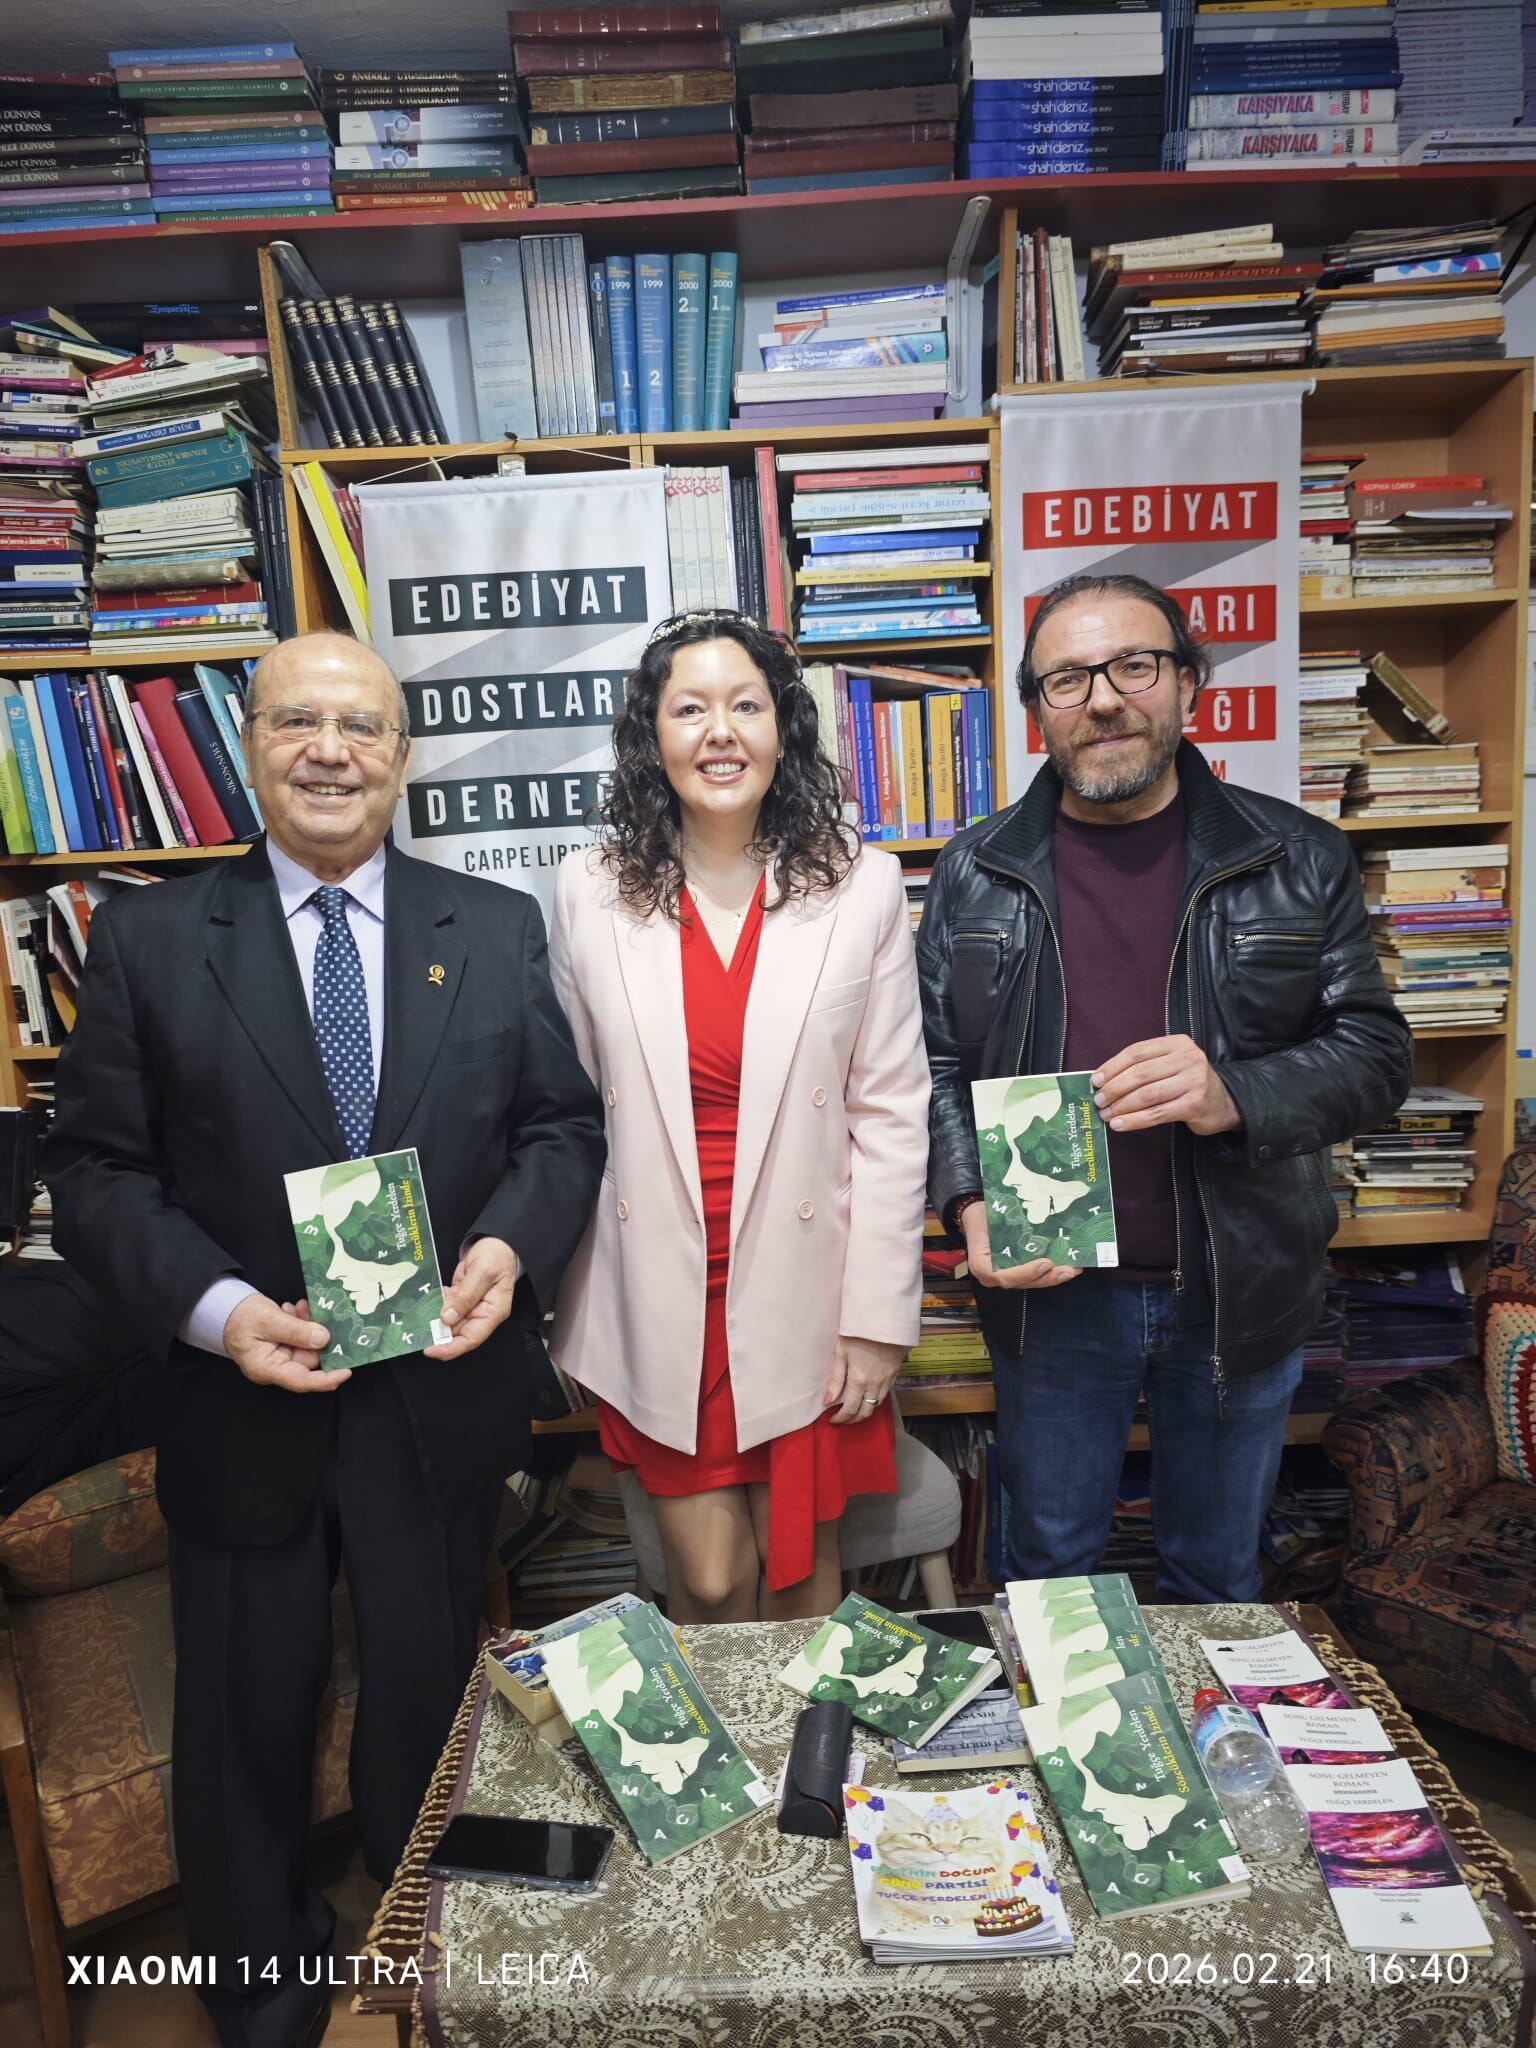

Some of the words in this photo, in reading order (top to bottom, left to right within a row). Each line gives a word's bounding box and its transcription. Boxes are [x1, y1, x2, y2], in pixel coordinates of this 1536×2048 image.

[1238, 96, 1314, 119] KARŞIYAKA
[1242, 134, 1318, 158] KARŞIYAKA
[611, 282, 630, 290] 1999
[643, 280, 663, 289] 1999
[678, 282, 698, 290] 2000
[713, 280, 733, 289] 2000
[678, 297, 688, 313] 2
[1044, 487, 1257, 538] EDEBİYAT
[411, 573, 626, 624] EDEBİYAT
[464, 846, 530, 872] CARPE
[1065, 1103, 1076, 1140] Yerdelen
[1068, 1142, 1081, 1170] Tuğçe
[1082, 1131, 1096, 1182] Sözcüklerin
[386, 1182, 400, 1223] Yerdelen
[392, 1222, 407, 1251] Tuğçe
[406, 1206, 423, 1260] Sözcüklerin
[650, 1667, 674, 1703] Yerdelen
[668, 1704, 689, 1728] Tuğçe
[675, 1688, 710, 1734] Sözcüklerin
[1129, 1710, 1151, 1752] Yerdelen
[1149, 1753, 1167, 1782] Tuğçe
[1160, 1734, 1190, 1794] Sözcüklerin
[1337, 1771, 1388, 1779] GELMEYEN
[1332, 1779, 1370, 1787] ROMAN
[925, 1879, 988, 1890] PARTİSİ
[939, 1865, 996, 1878] DOĞUM
